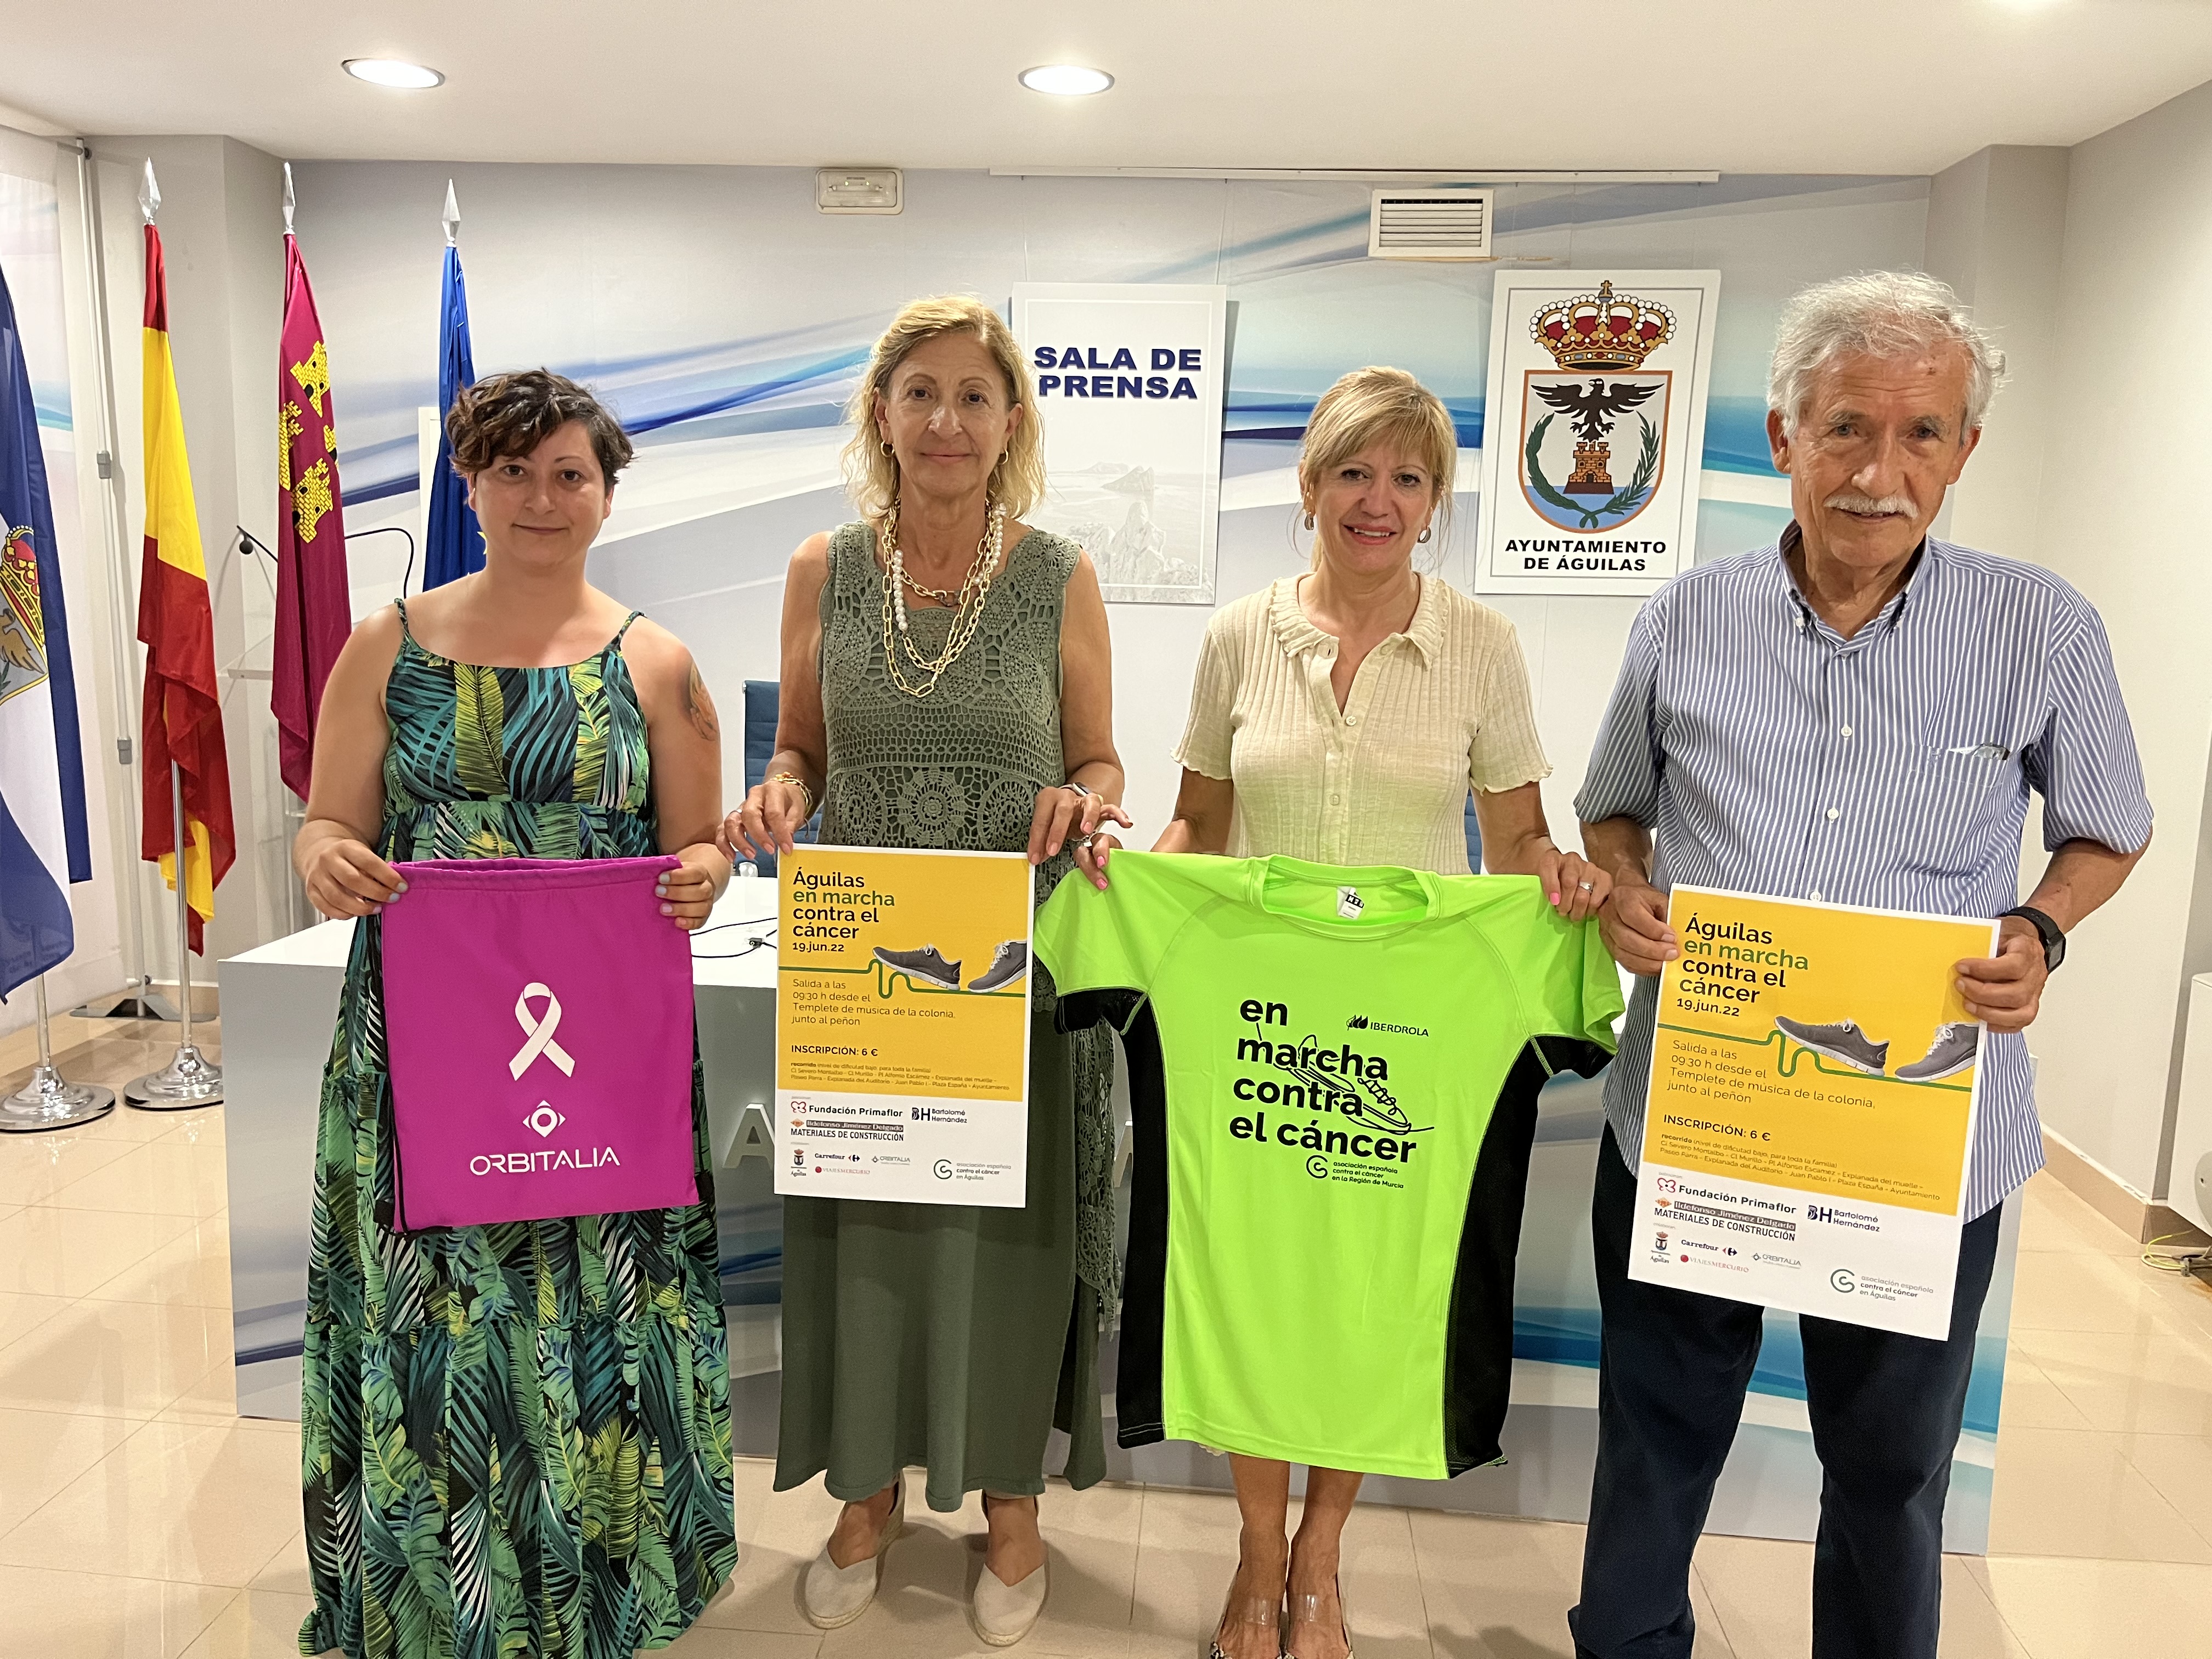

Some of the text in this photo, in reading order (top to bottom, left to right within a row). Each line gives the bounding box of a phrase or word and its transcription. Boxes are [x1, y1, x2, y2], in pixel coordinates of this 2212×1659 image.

[1034, 347, 1201, 371] SALA DE
[1039, 375, 1198, 399] PRENSA
[1505, 539, 1666, 554] AYUNTAMIENTO
[1524, 555, 1645, 571] DE ÁGUILAS
[793, 866, 865, 890] Águilas
[793, 890, 895, 906] en marcha
[793, 906, 879, 923] contra el
[793, 921, 859, 939] cáncer
[1685, 912, 1772, 945] Águilas
[792, 941, 844, 953] 19.jun.22
[1684, 940, 1808, 970] en marcha
[793, 978, 822, 988] Salida
[833, 980, 846, 989] las
[1682, 960, 1786, 988] contra el
[820, 991, 827, 1000] h
[829, 992, 859, 1002] desde
[861, 994, 871, 1002] el
[1679, 977, 1760, 1003] cáncer
[792, 1002, 839, 1013] Templete
[841, 1005, 854, 1013] de
[893, 1007, 905, 1015] de
[908, 1007, 916, 1016] la
[1240, 1000, 1288, 1026] en
[1677, 998, 1740, 1017] 19.jun.22
[791, 1015, 816, 1024] junto
[819, 1015, 827, 1024] al
[1370, 1022, 1429, 1037] IBERDROLA
[791, 1045, 878, 1057] INSCRIPCIÓN: 6 €
[1237, 1038, 1388, 1080] marcha
[1672, 1040, 1707, 1054] Salida
[1720, 1048, 1737, 1060] las
[1705, 1059, 1712, 1069] h
[1715, 1062, 1752, 1076] desde
[1755, 1069, 1766, 1079] el
[1666, 1080, 1697, 1093] junto
[1700, 1087, 1711, 1097] al
[1670, 1066, 1726, 1085] Templete
[1729, 1078, 1745, 1088] de
[1794, 1088, 1810, 1099] de
[1813, 1090, 1824, 1101] la
[1233, 1078, 1363, 1117] contra
[809, 1105, 903, 1117] Fundación Primaflor
[791, 1128, 836, 1138] MATERIALES
[850, 1128, 904, 1141] CONSTRUCCIÓN
[1229, 1112, 1417, 1163] el cáncer
[1663, 1114, 1770, 1141] INSCRIPCIÓN: 6 €
[470, 1147, 620, 1176] ORBITALIA
[1382, 1180, 1404, 1188] Murcia
[1679, 1184, 1797, 1214] Fundación Primaflor
[1654, 1207, 1796, 1242] MATERIALES DE CONSTRUCCIÓN
